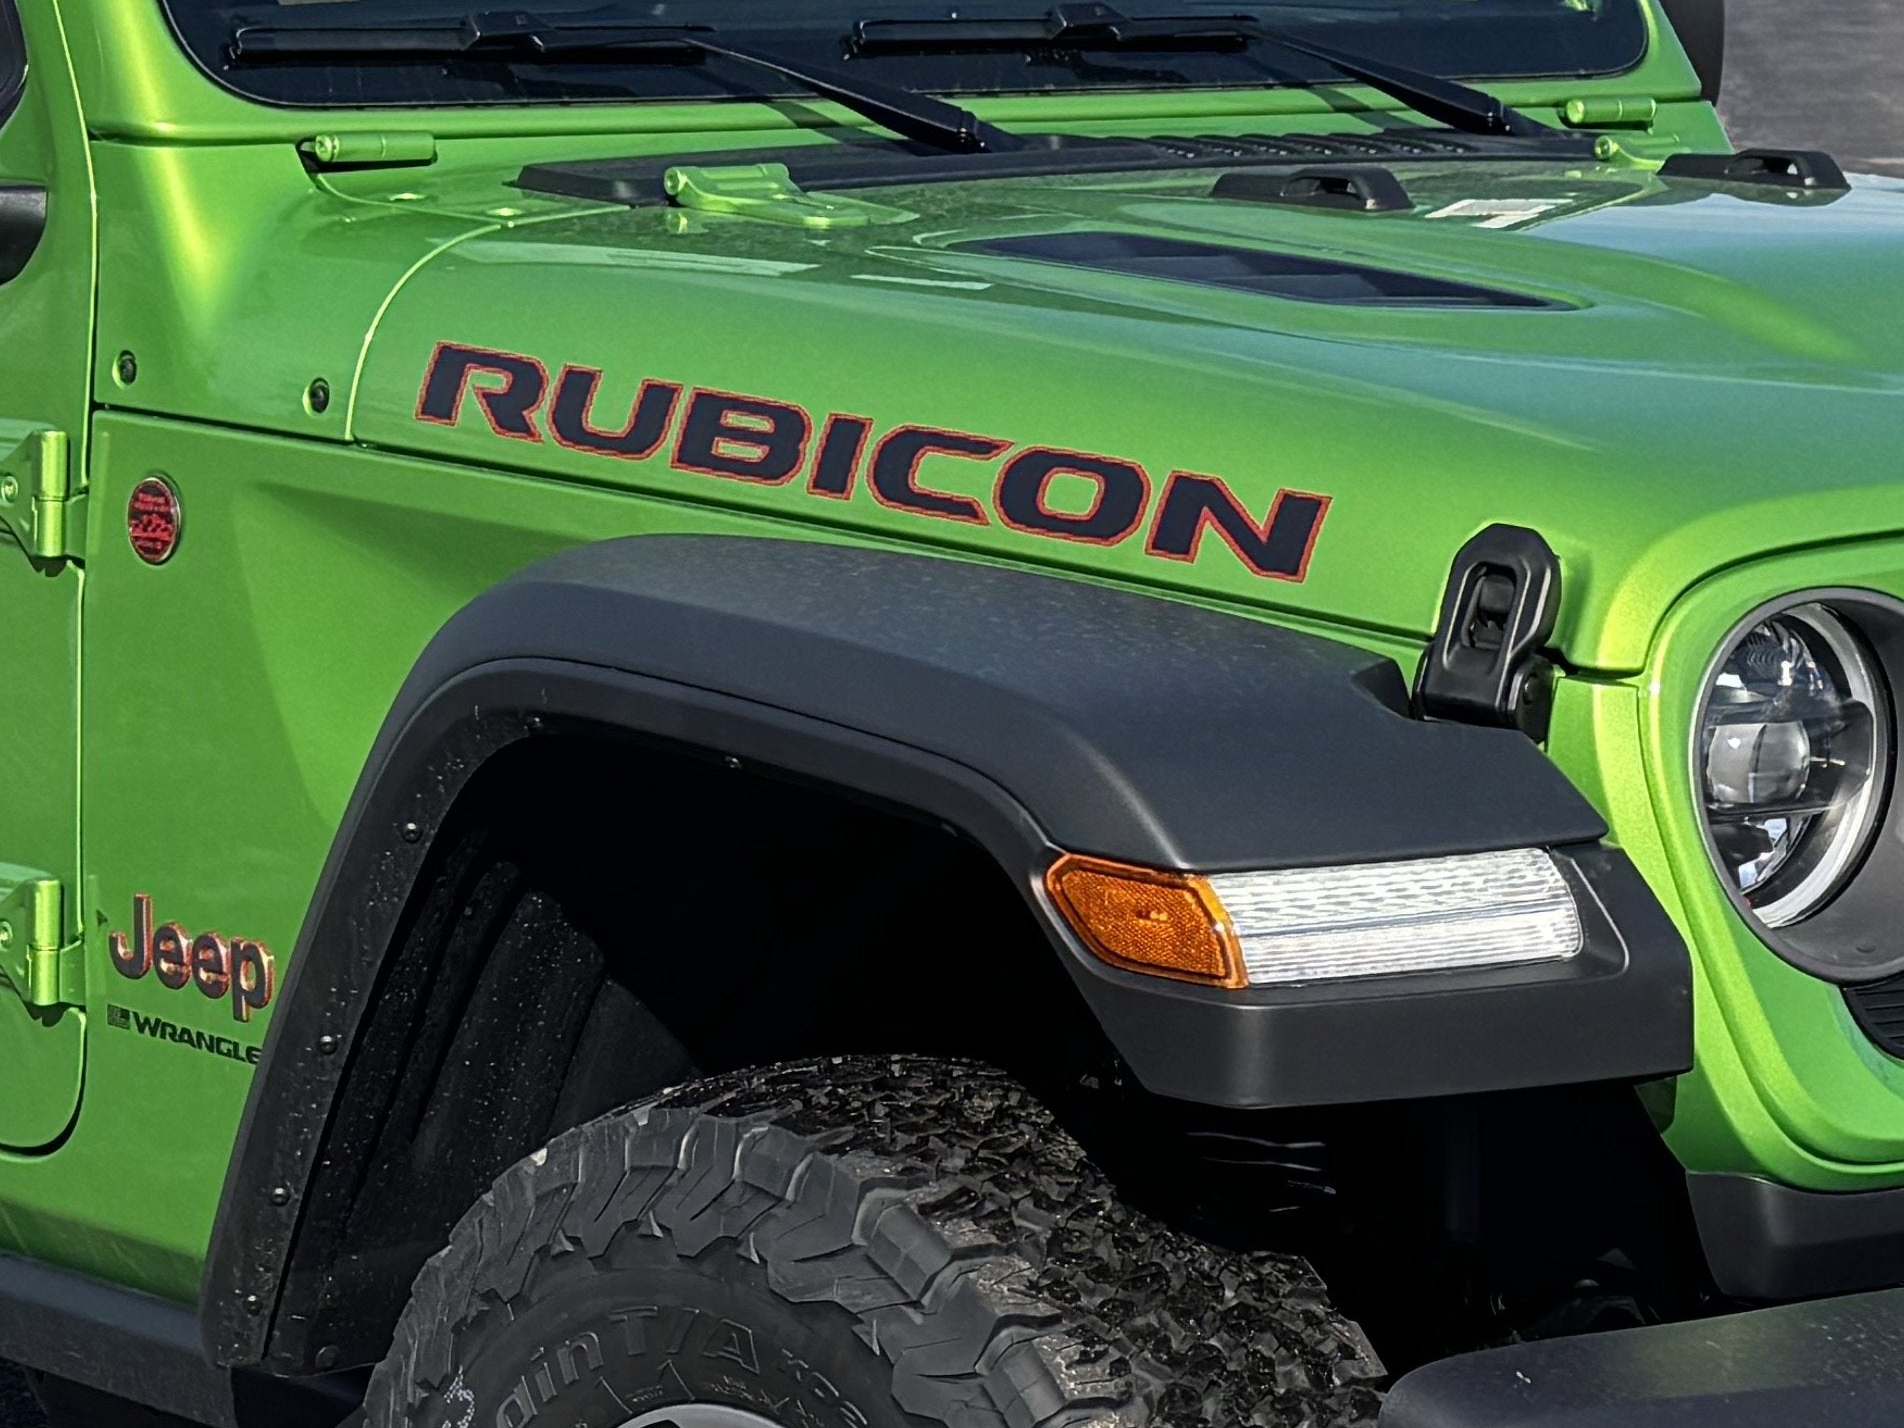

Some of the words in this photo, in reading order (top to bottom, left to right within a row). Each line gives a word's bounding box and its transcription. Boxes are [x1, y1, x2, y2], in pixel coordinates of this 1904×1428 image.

[414, 340, 1332, 584] RUBICON
[109, 892, 274, 1023] Jeep
[132, 1011, 263, 1065] WRANGLE
